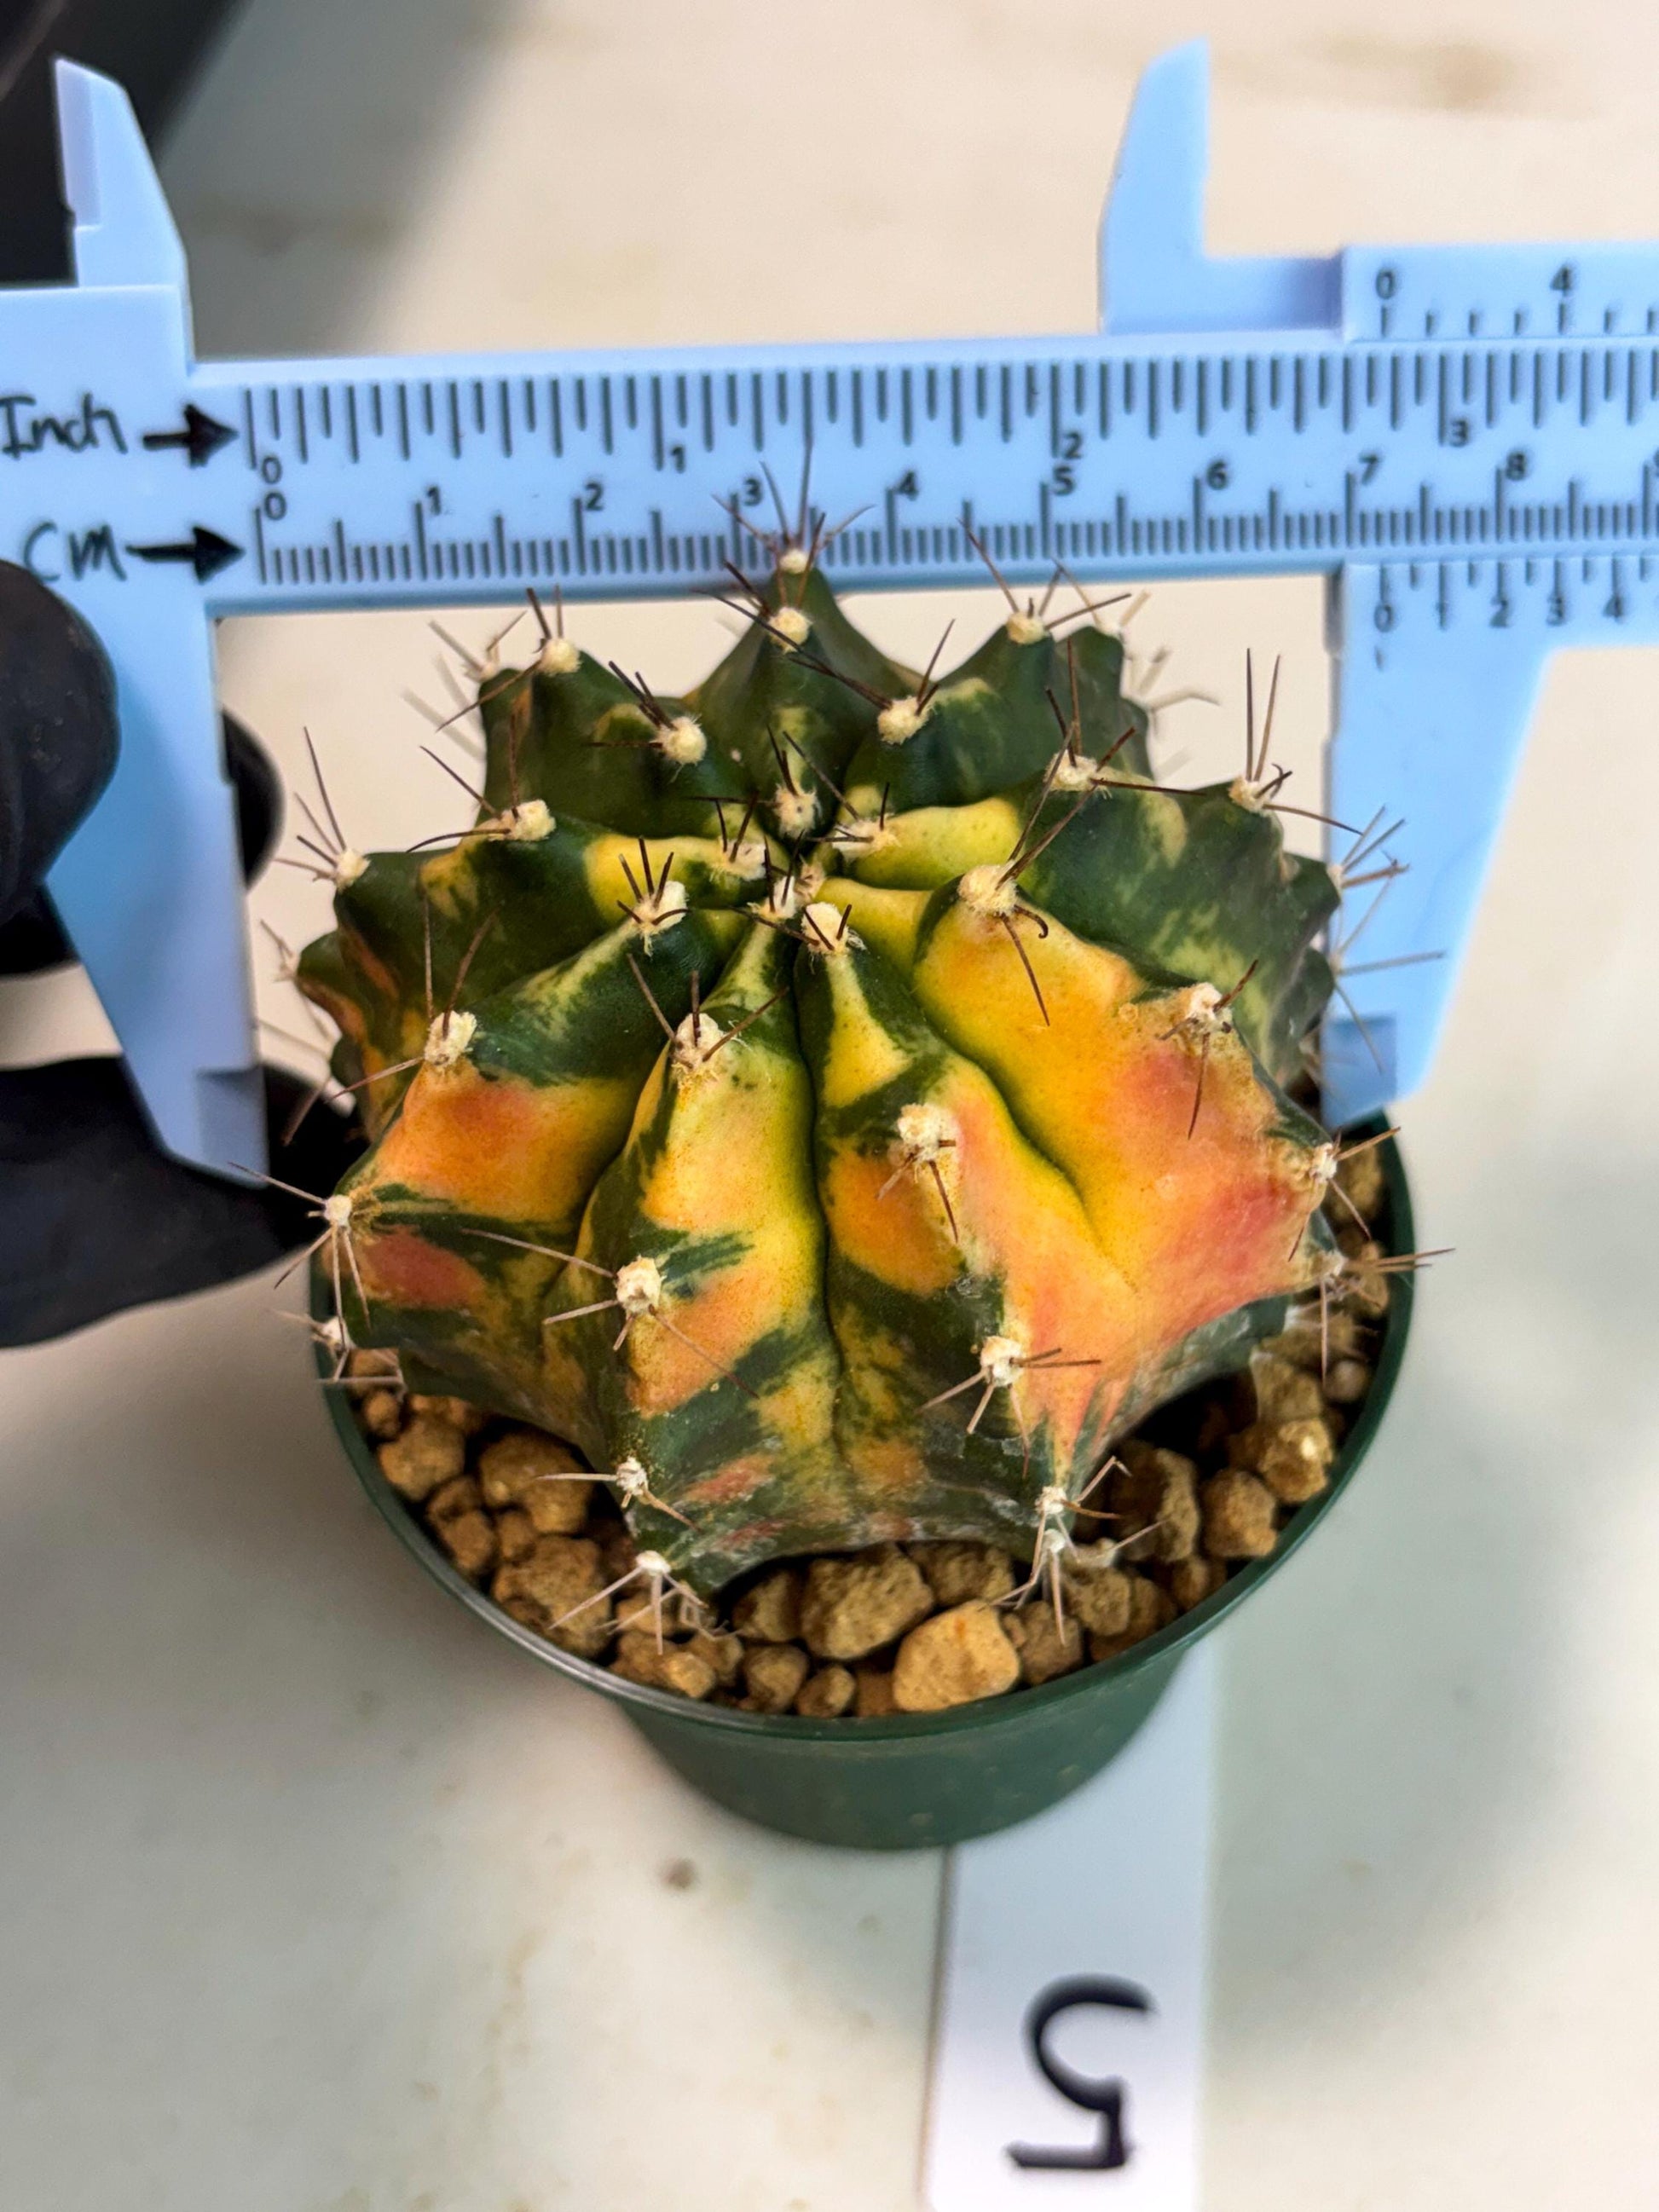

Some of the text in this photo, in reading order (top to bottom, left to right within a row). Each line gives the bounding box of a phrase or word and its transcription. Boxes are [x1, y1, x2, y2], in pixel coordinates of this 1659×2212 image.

[1375, 264, 1572, 299] 0 4
[0, 390, 128, 459] Inch
[262, 419, 1470, 485] 0 1 2 3
[263, 449, 1527, 521] 0 1 2 3 4 5 6 7 8
[1373, 602, 1396, 632] 0
[1489, 598, 1508, 628] 2
[1603, 592, 1623, 623] 4
[1005, 1972, 1152, 2170] 5
